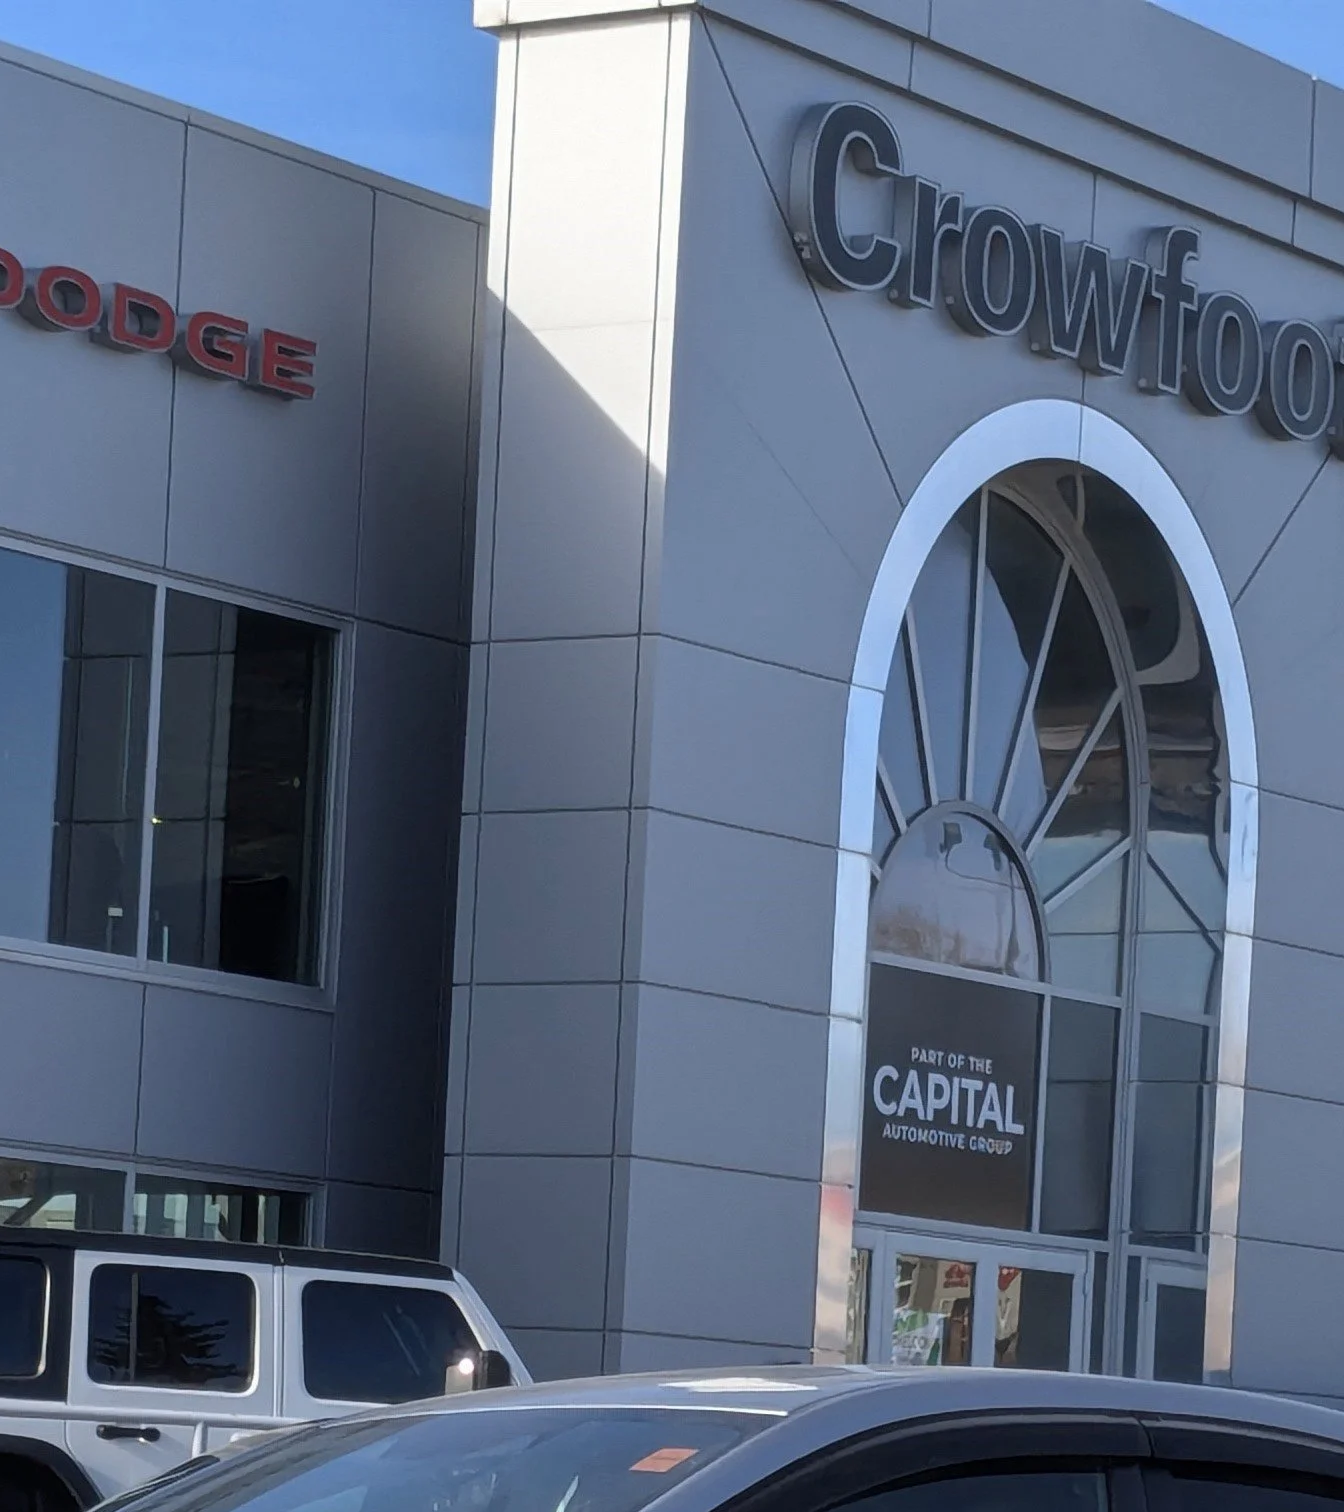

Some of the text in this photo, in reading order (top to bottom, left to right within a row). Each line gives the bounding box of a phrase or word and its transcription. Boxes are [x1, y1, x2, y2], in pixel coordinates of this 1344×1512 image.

[911, 1047, 993, 1075] PART OF THE
[873, 1065, 1025, 1135] CAPITAL
[882, 1122, 1013, 1155] AUTOMOTIVE GROUP
